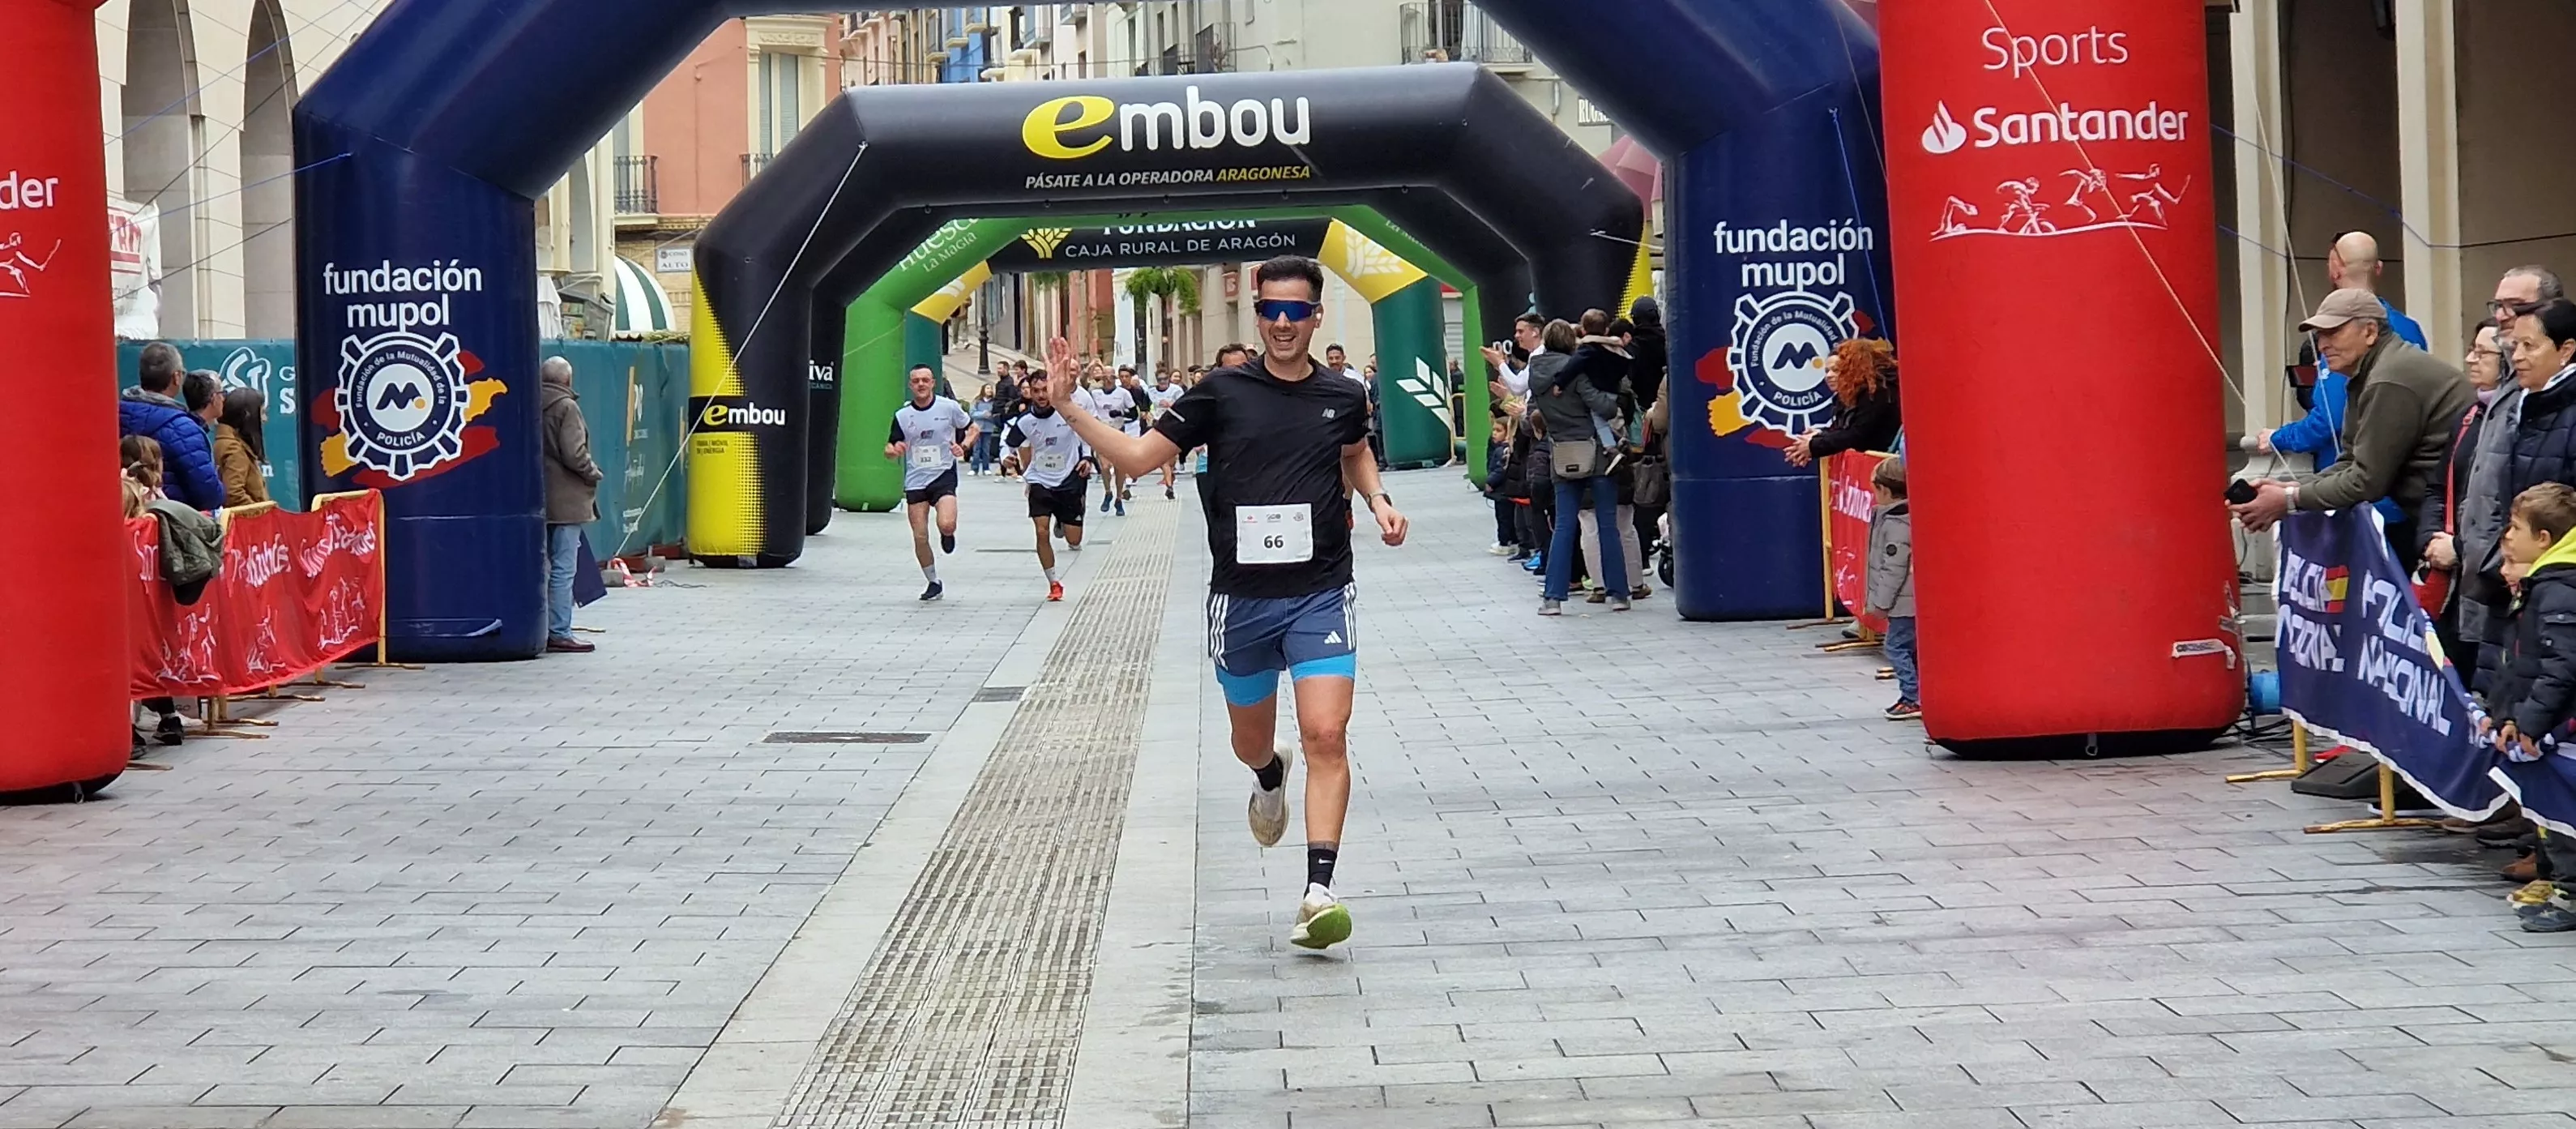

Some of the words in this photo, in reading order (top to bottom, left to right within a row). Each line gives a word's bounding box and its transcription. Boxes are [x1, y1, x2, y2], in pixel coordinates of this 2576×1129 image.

[1981, 25, 2130, 79] Sports
[1022, 85, 1311, 160] embou
[1973, 100, 2189, 148] Santander
[0, 170, 58, 210] der
[1025, 172, 1081, 189] PÁSATE
[1083, 173, 1094, 187] A
[1097, 173, 1115, 186] LA
[1119, 169, 1214, 186] OPERADORA
[1216, 165, 1310, 182] ARAGONESA
[1065, 243, 1113, 258] CAJA
[1120, 241, 1181, 254] RURAL
[1187, 239, 1211, 252] DE
[1217, 232, 1296, 250] ARAGÓN
[1713, 218, 1873, 253] fundación
[323, 259, 482, 294] fundación
[1742, 253, 1845, 292] mupol
[348, 293, 450, 332] mupol
[1750, 323, 1771, 367] Fundación
[1771, 315, 1782, 325] de
[1783, 311, 1792, 320] la
[1795, 310, 1839, 341] Mutualidad
[374, 357, 385, 366] de
[397, 351, 442, 382] Mutualidad
[355, 365, 374, 408] Fundación
[436, 382, 445, 394] de
[438, 396, 447, 404] la
[1773, 391, 1823, 406] POLICÍA
[703, 402, 785, 426] embou
[376, 431, 425, 447] POLICÍA
[1264, 535, 1284, 549] 66
